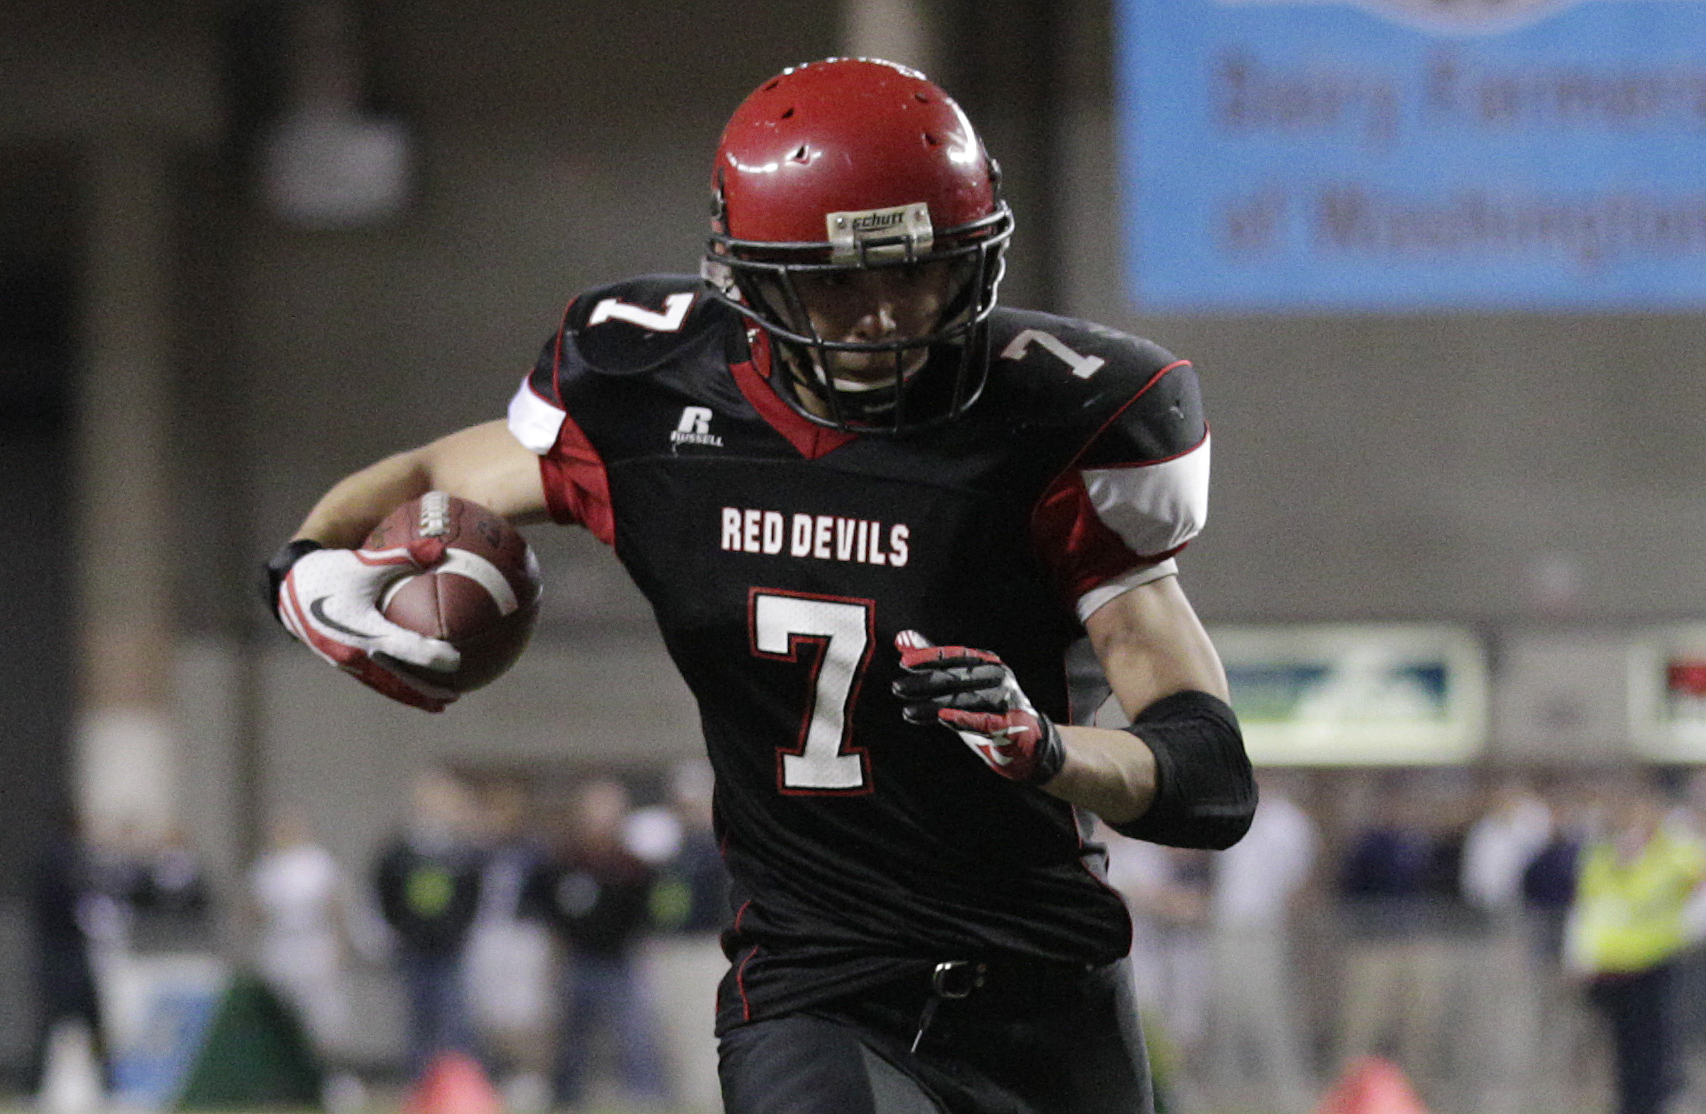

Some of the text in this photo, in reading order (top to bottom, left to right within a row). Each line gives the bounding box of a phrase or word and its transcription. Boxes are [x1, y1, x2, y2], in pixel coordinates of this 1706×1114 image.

[853, 211, 904, 231] schutt
[1213, 184, 1286, 260] of
[587, 291, 700, 333] 7
[999, 328, 1106, 380] 7
[677, 405, 713, 434] R
[720, 505, 910, 568] RED DEVILS
[748, 586, 876, 796] 7
